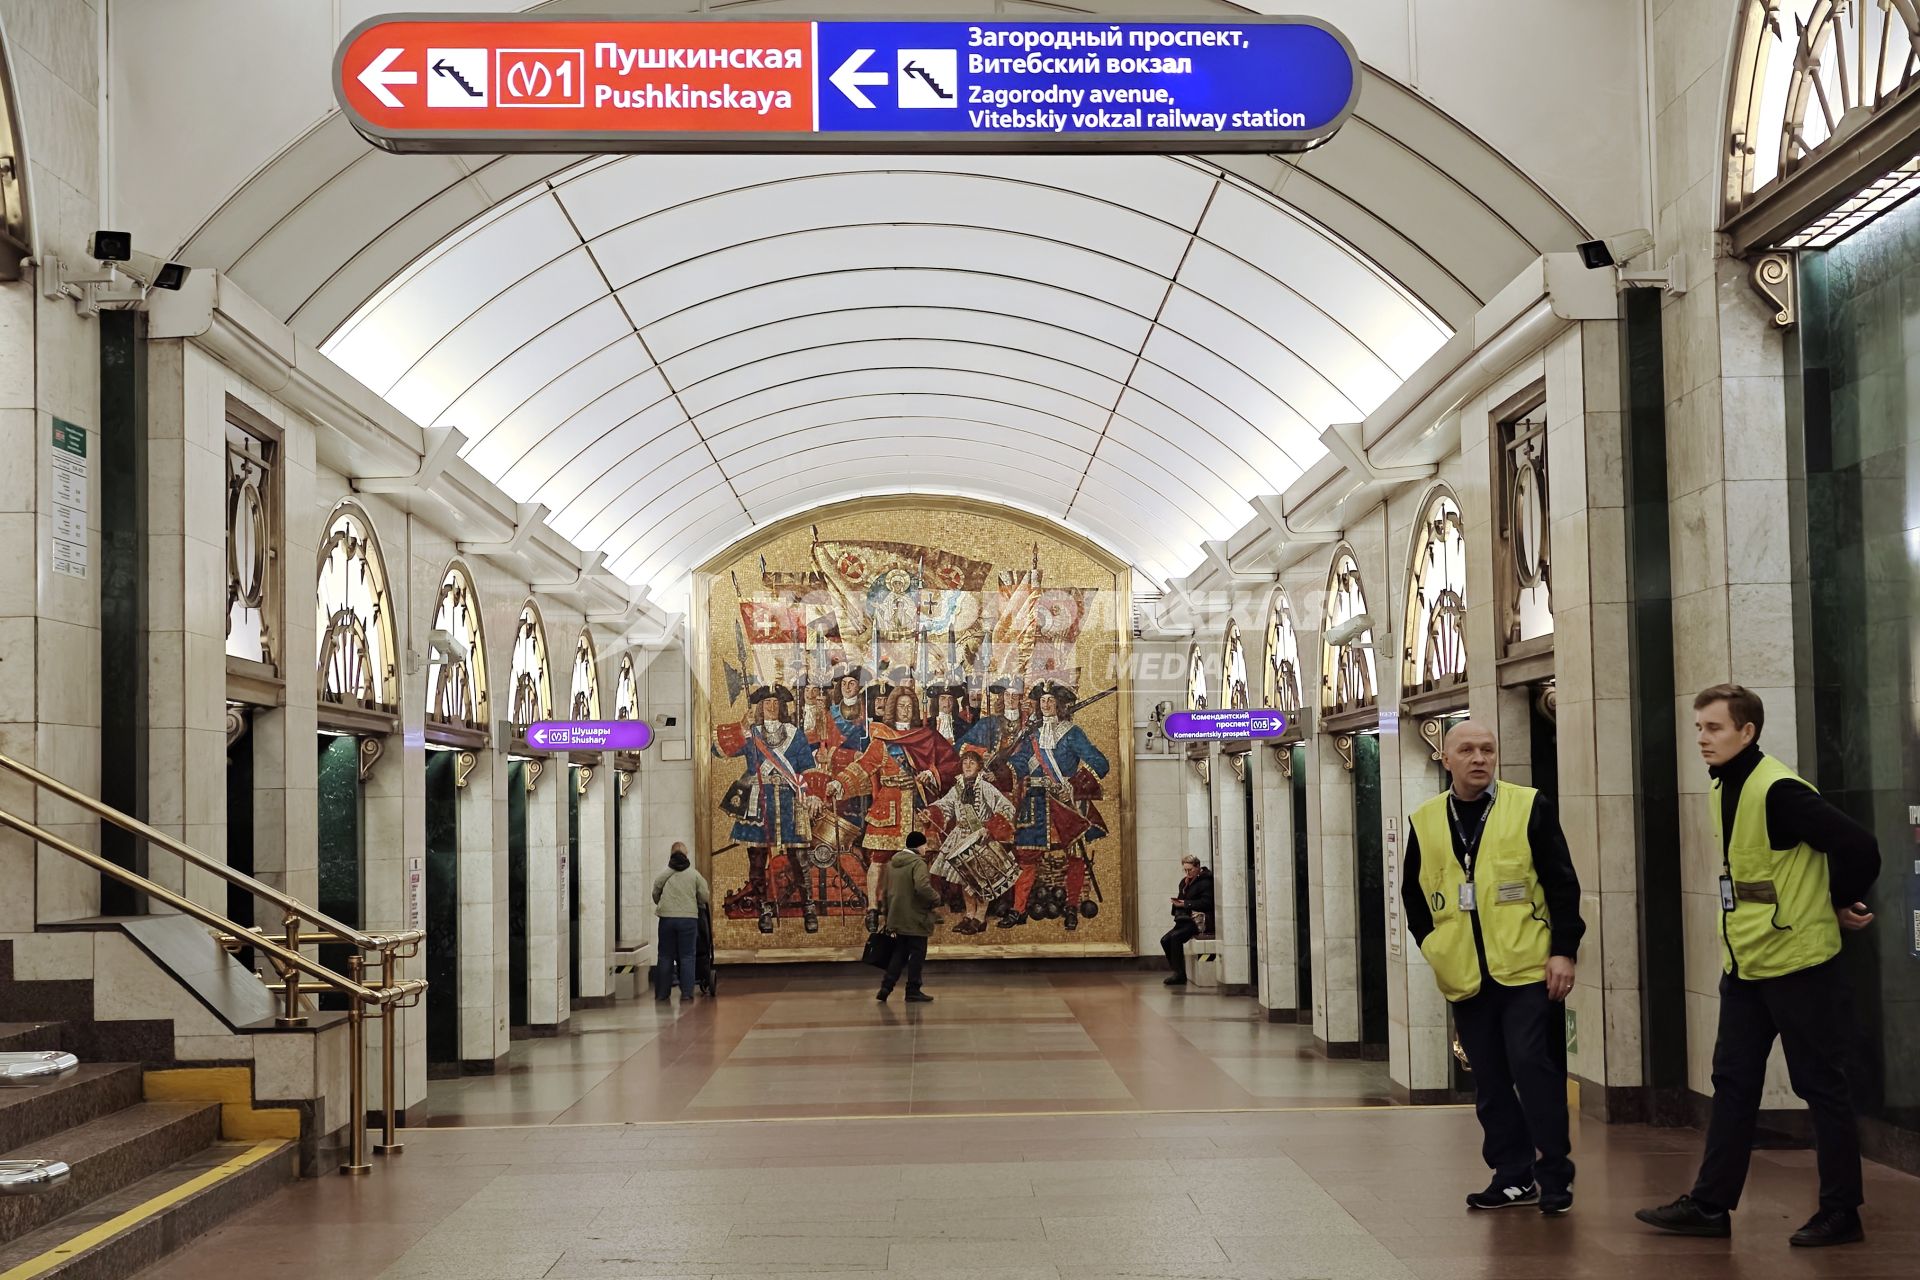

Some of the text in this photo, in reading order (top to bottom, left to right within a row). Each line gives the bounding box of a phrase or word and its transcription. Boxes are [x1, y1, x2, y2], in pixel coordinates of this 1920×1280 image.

[968, 26, 1249, 51] Загородный проспект,
[594, 42, 803, 74] Пушкинская
[968, 52, 1192, 74] Витебский вокзал
[595, 83, 792, 115] Pushkinskaya
[968, 83, 1175, 107] Zagorodny avenue,
[968, 108, 1306, 132] Vitebskiy vokzal railway station
[1191, 712, 1250, 721] Комендантский
[1215, 721, 1250, 729] проспект
[571, 727, 611, 736] Шушары
[571, 736, 606, 745] Shushary
[1222, 730, 1251, 739] prospekt
